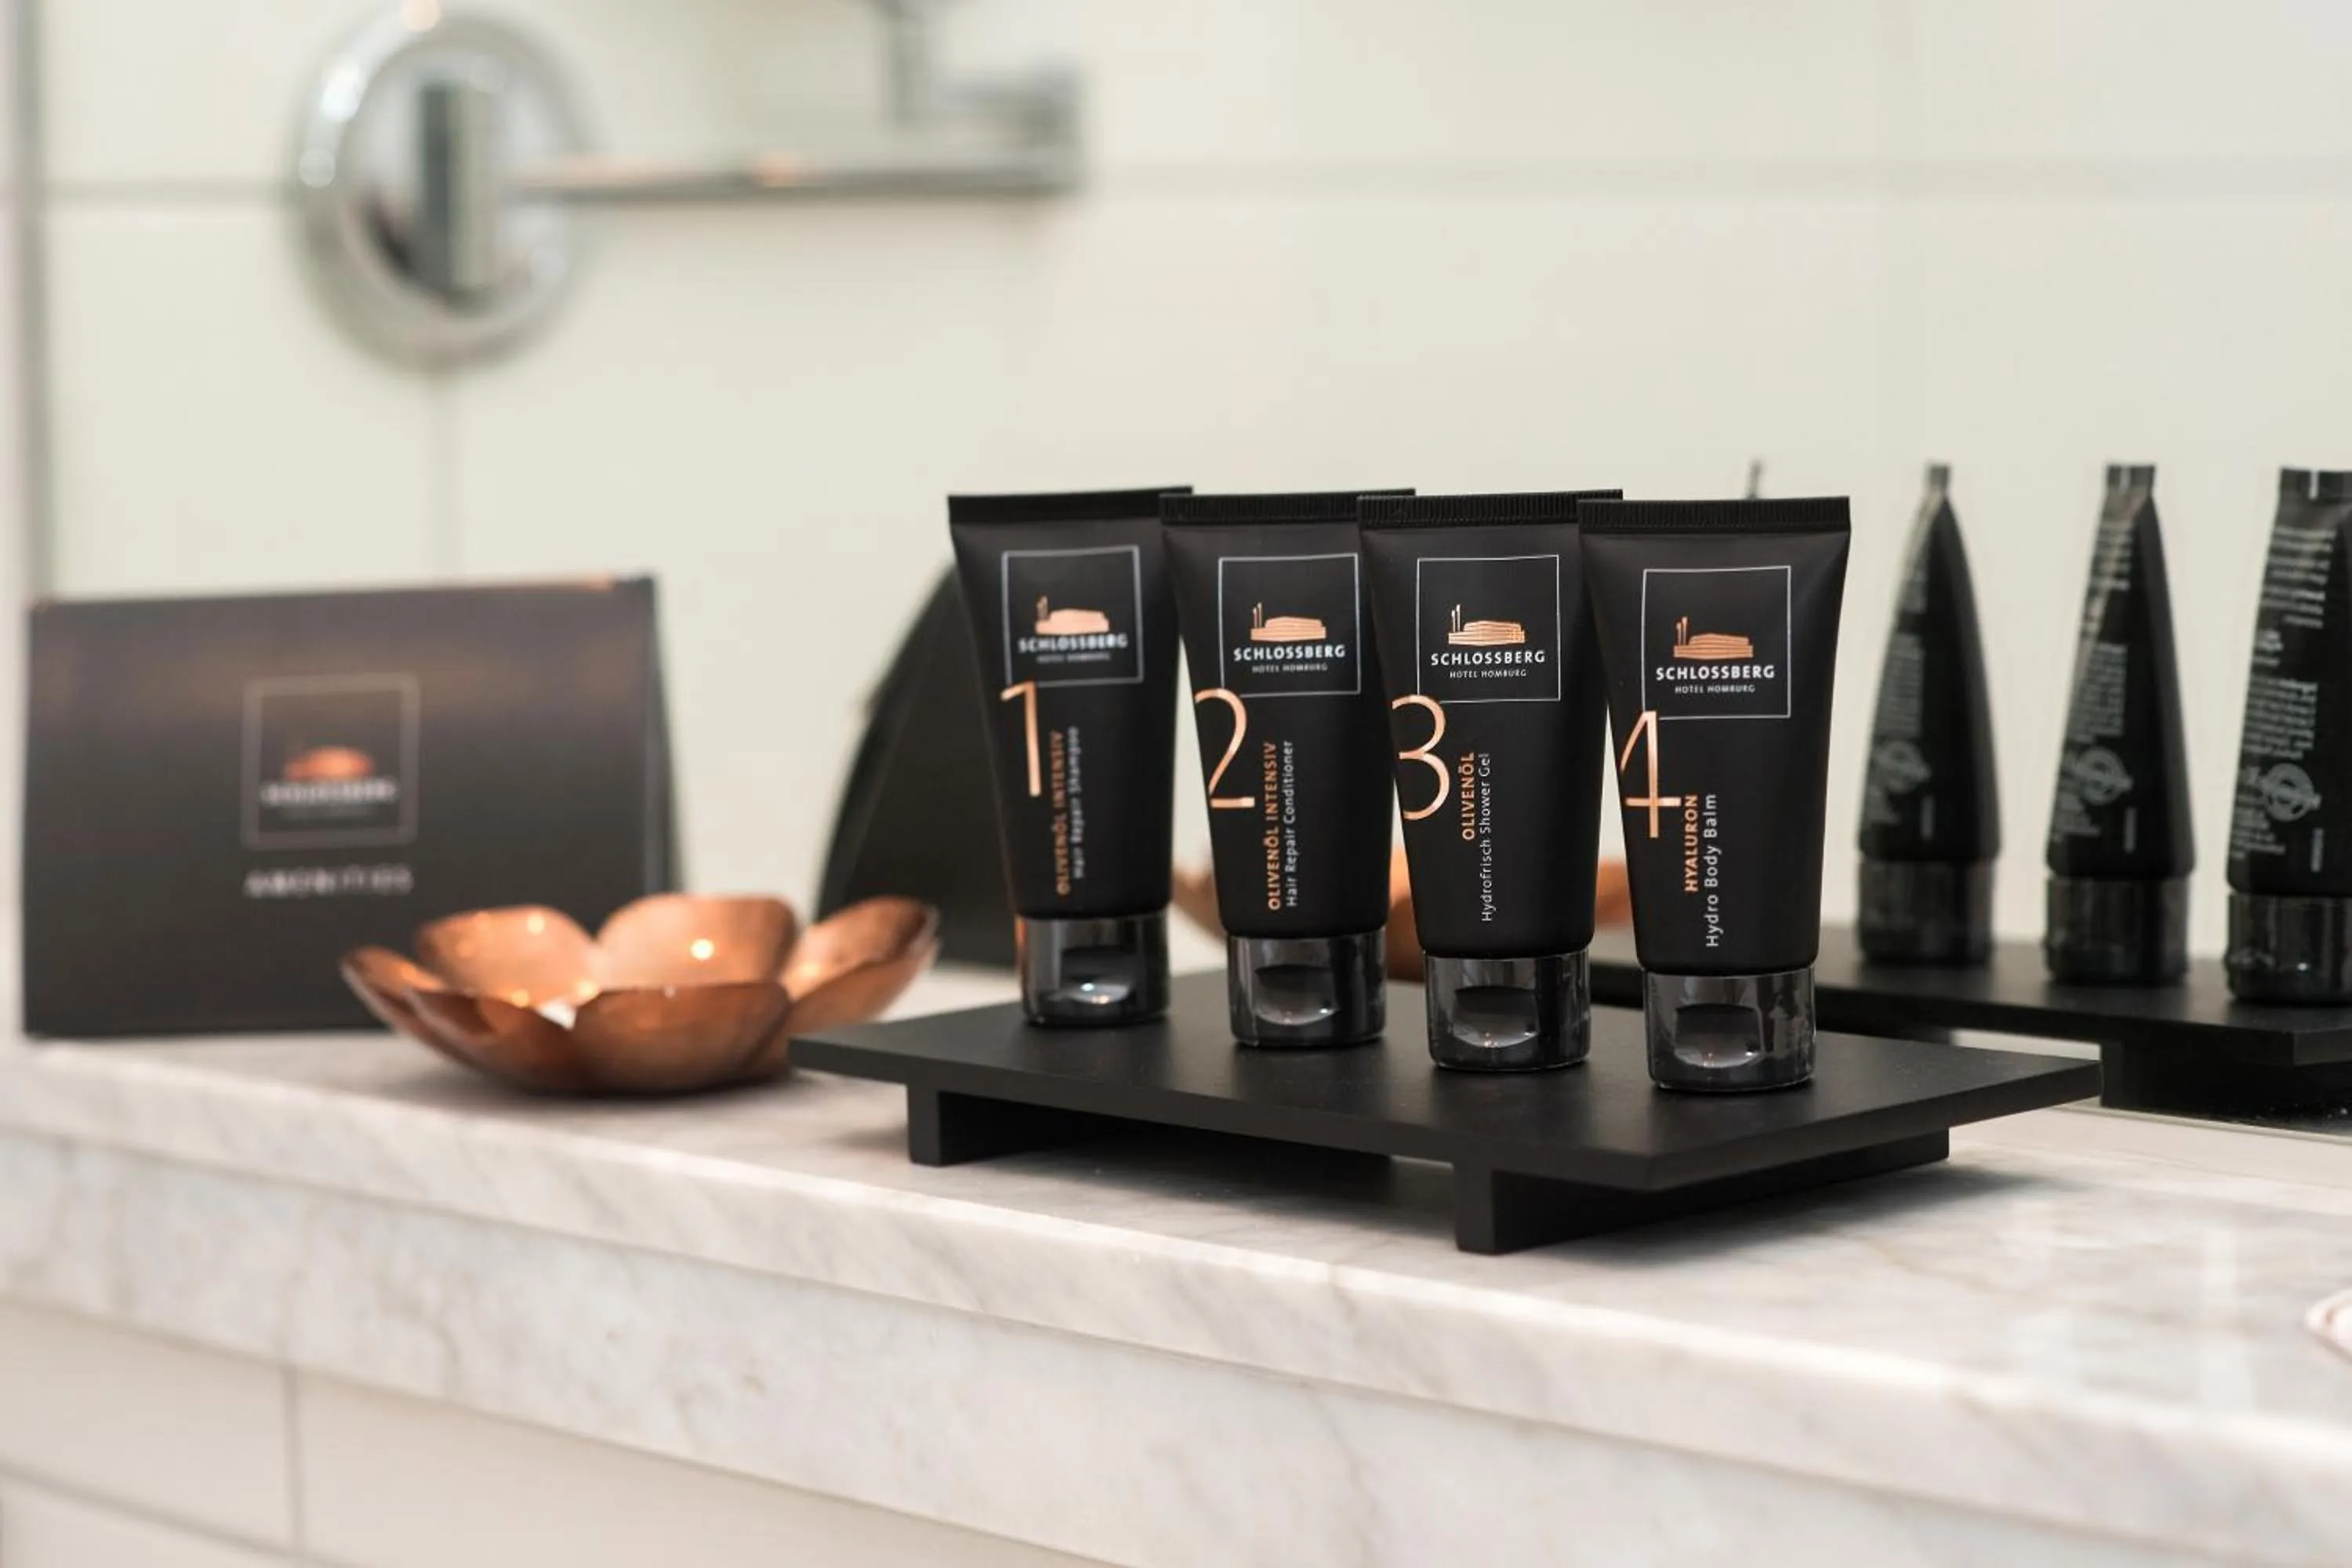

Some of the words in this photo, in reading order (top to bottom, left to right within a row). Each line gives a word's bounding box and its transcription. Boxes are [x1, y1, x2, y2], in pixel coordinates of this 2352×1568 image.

[1018, 633, 1128, 652] SCHLOSSBERG
[1233, 644, 1345, 662] SCHLOSSBERG
[1431, 650, 1545, 666] SCHLOSSBERG
[1252, 665, 1279, 673] HOTEL
[1283, 662, 1328, 672] HOMBURG
[1482, 669, 1526, 677] HOMBURG
[1656, 665, 1775, 681] SCHLOSSBERG
[1675, 684, 1704, 694] HOTEL
[1707, 684, 1755, 693] HOMBURG
[1000, 681, 1041, 797] 1
[1068, 726, 1081, 793] Shampoo
[1195, 688, 1255, 808] 2
[1392, 694, 1450, 820] 3
[1263, 742, 1279, 820] INTENSIV
[1281, 741, 1294, 824] Conditioner
[1478, 753, 1490, 777] Gel
[1620, 710, 1682, 838] 4
[1458, 752, 1475, 840] OLIVENÖL
[1479, 782, 1491, 833] Shower
[1702, 793, 1717, 838] Balm
[1070, 797, 1085, 843] Repair
[1685, 794, 1699, 892] HYALURON
[1072, 847, 1085, 879] Hair
[1262, 826, 1281, 910] OLIVENÖL
[1284, 828, 1299, 873] Repair
[1703, 844, 1722, 887] Body
[1285, 877, 1298, 907] Hair
[1479, 840, 1496, 921] Hydrofrisch
[1704, 894, 1723, 947] Hydro
